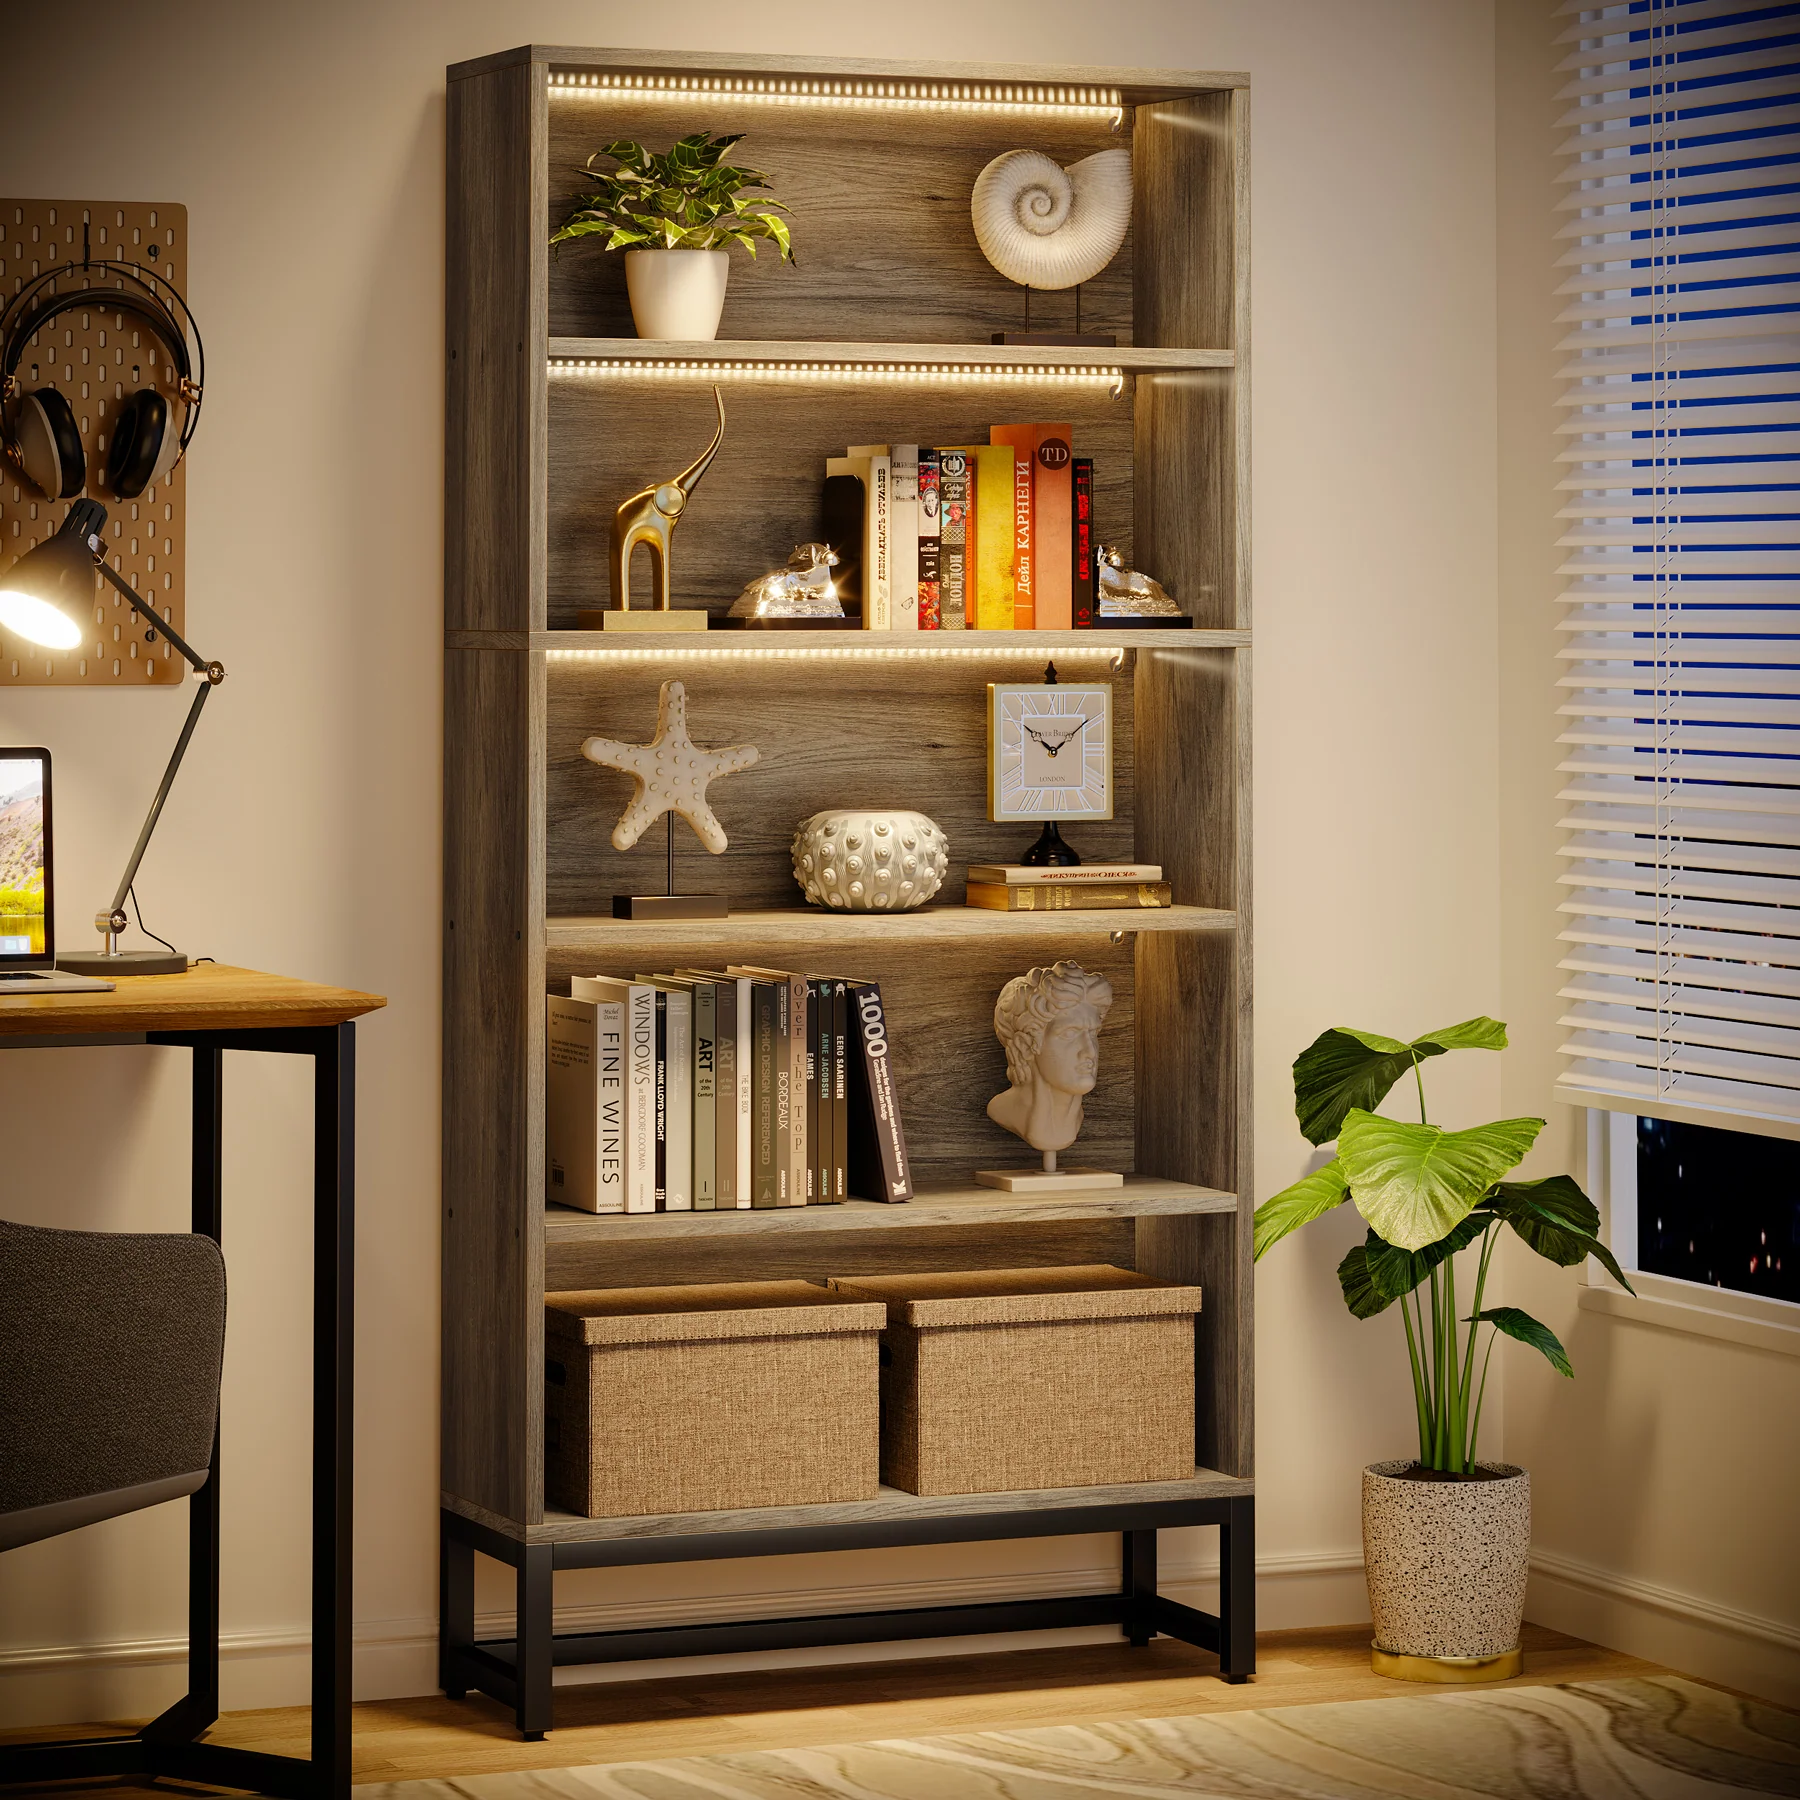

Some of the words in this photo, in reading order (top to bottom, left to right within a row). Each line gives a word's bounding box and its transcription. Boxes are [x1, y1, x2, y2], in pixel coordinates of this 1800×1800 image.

[1042, 447, 1068, 462] TD
[878, 468, 886, 515] СТУЛЬЕВ
[1016, 461, 1030, 550] КАРНЕГИ
[878, 516, 886, 581] ДВЕНАДЦАТЬ
[950, 554, 964, 606] ЛОНДОН
[1018, 556, 1030, 595] Дейл
[634, 993, 650, 1085] WINDOWS
[762, 1005, 771, 1052] GRAPHIC
[859, 992, 888, 1057] 1000
[603, 1032, 620, 1088] FINE
[699, 1037, 712, 1072] ART
[720, 1036, 734, 1071] ART
[762, 1054, 771, 1093] DESIGN
[873, 1059, 882, 1084] Geraldine
[638, 1094, 646, 1132] BERGDORF
[778, 1071, 788, 1130] BORDEAUX
[603, 1100, 620, 1184] WINES
[638, 1132, 646, 1171] GOODMAN
[762, 1096, 771, 1165] REFERENCED
